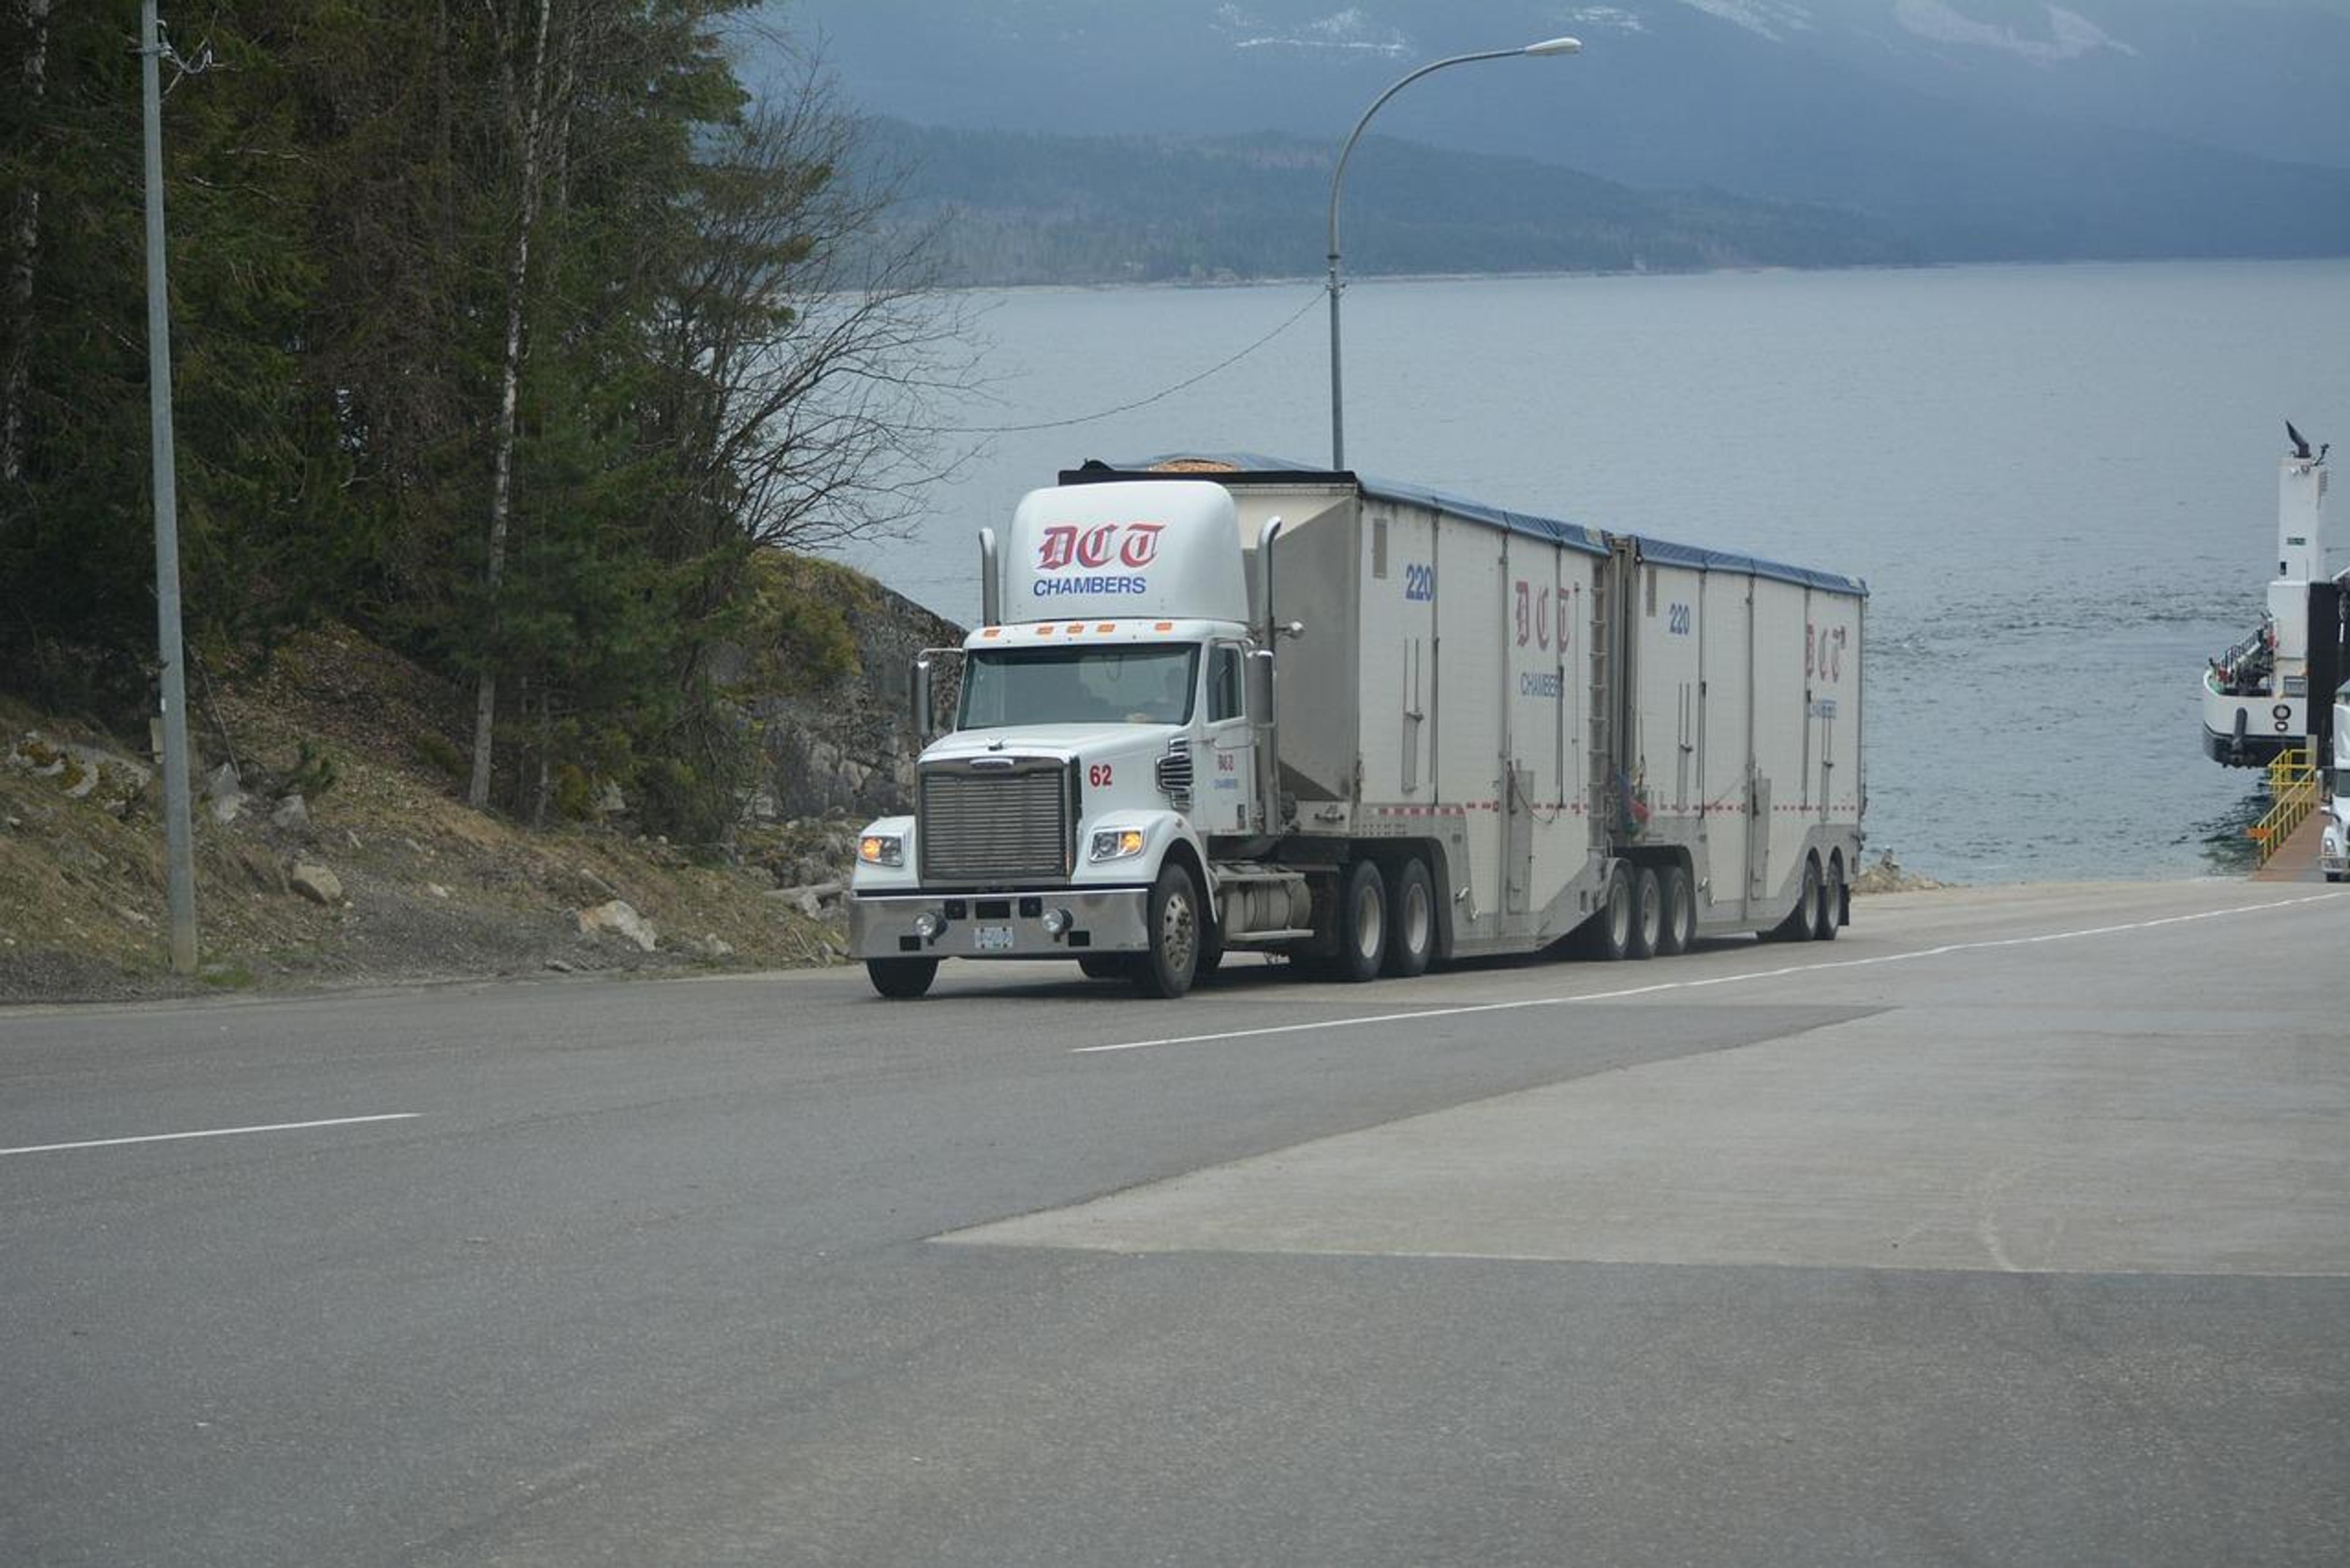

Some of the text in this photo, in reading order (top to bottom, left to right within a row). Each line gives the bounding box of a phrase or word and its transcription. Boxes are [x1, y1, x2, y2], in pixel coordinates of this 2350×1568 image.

[1035, 523, 1166, 570] DCT
[1033, 577, 1146, 596] CHAMBERS
[1406, 564, 1433, 602] 220
[1515, 581, 1570, 654] DCT
[1669, 602, 1690, 635] 220
[1089, 764, 1113, 787] 62
